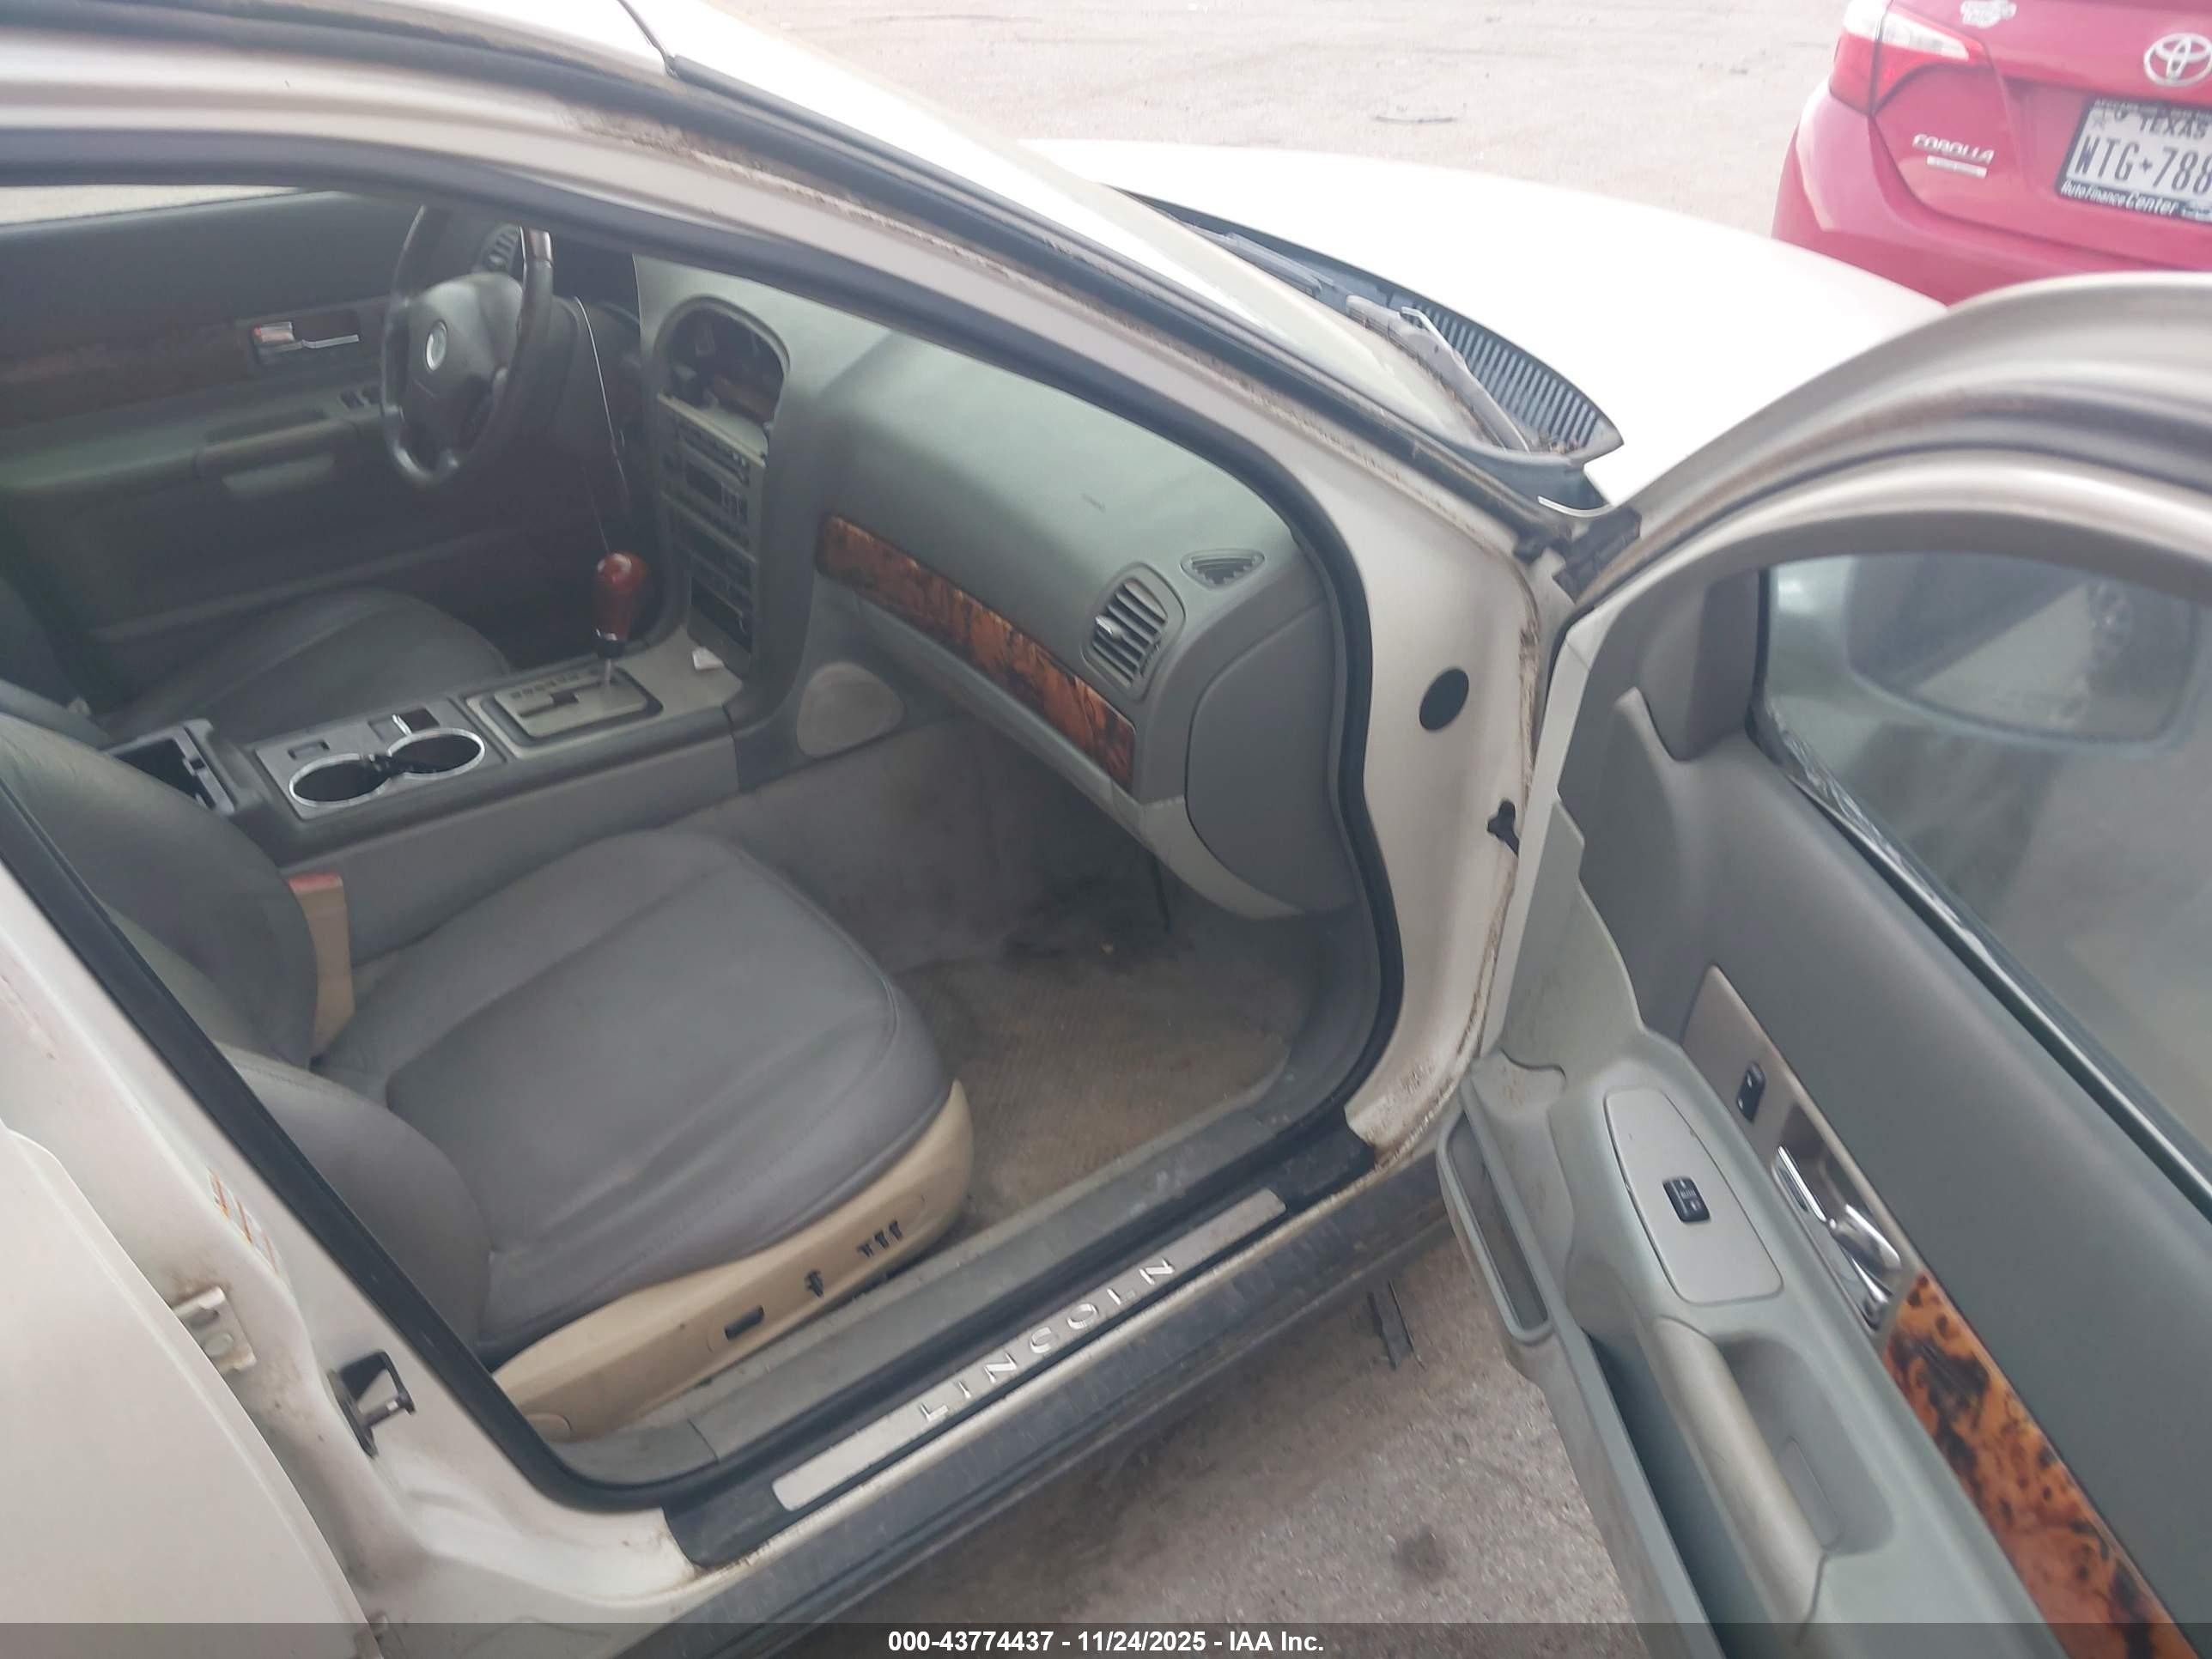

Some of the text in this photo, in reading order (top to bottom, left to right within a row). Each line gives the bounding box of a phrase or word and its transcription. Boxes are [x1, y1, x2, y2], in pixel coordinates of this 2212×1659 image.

[2137, 111, 2209, 140] TEXAS
[1911, 133, 1995, 165] COROLLA
[920, 1257, 1176, 1423] LINCOLN
